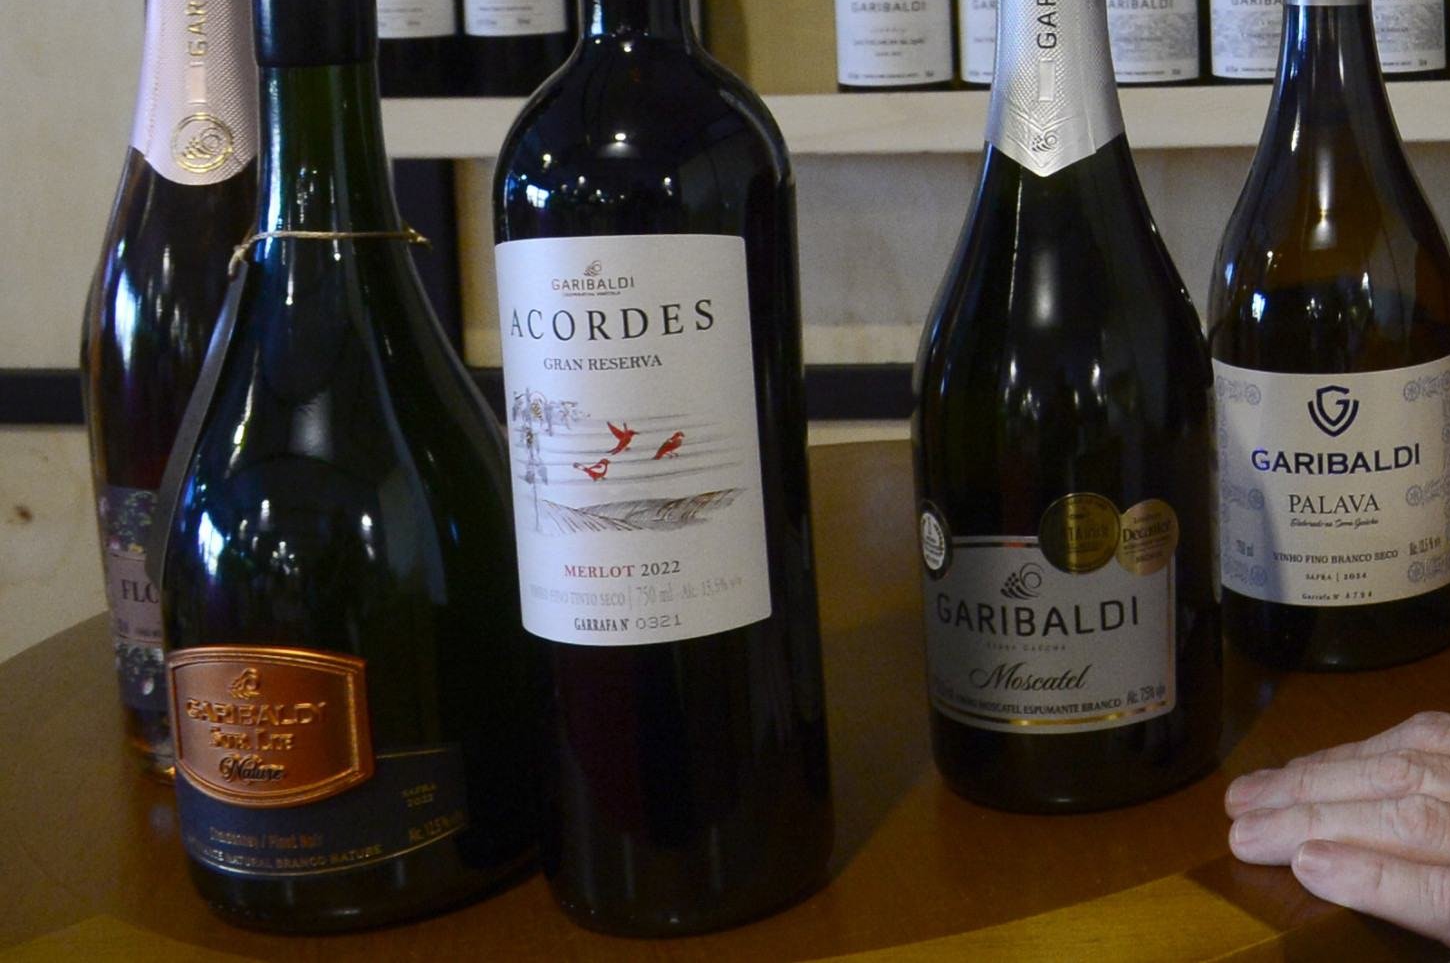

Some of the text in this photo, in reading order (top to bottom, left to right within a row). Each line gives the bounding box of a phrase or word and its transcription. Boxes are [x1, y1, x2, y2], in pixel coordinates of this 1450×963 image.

[851, 0, 927, 13] GARIBALDI
[551, 276, 635, 291] GARIBALDI
[510, 299, 714, 341] ACORDES
[544, 354, 663, 371] GRAN RESERVA
[1251, 443, 1420, 475] GARIBALDI
[1288, 493, 1380, 515] PALAVA
[1273, 549, 1398, 564] VINHO FINO BRANCO SECO
[564, 561, 681, 578] MERLOT 2022
[574, 617, 618, 632] GARRAFA
[635, 614, 682, 631] 0321
[937, 593, 1139, 637] GARIBALDI
[968, 661, 1092, 691] Moscatel
[187, 698, 326, 725] GARIBALDI
[1024, 703, 1078, 715] ESPUMANTE
[1081, 699, 1121, 713] BRANCO
[219, 754, 285, 782] Nature
